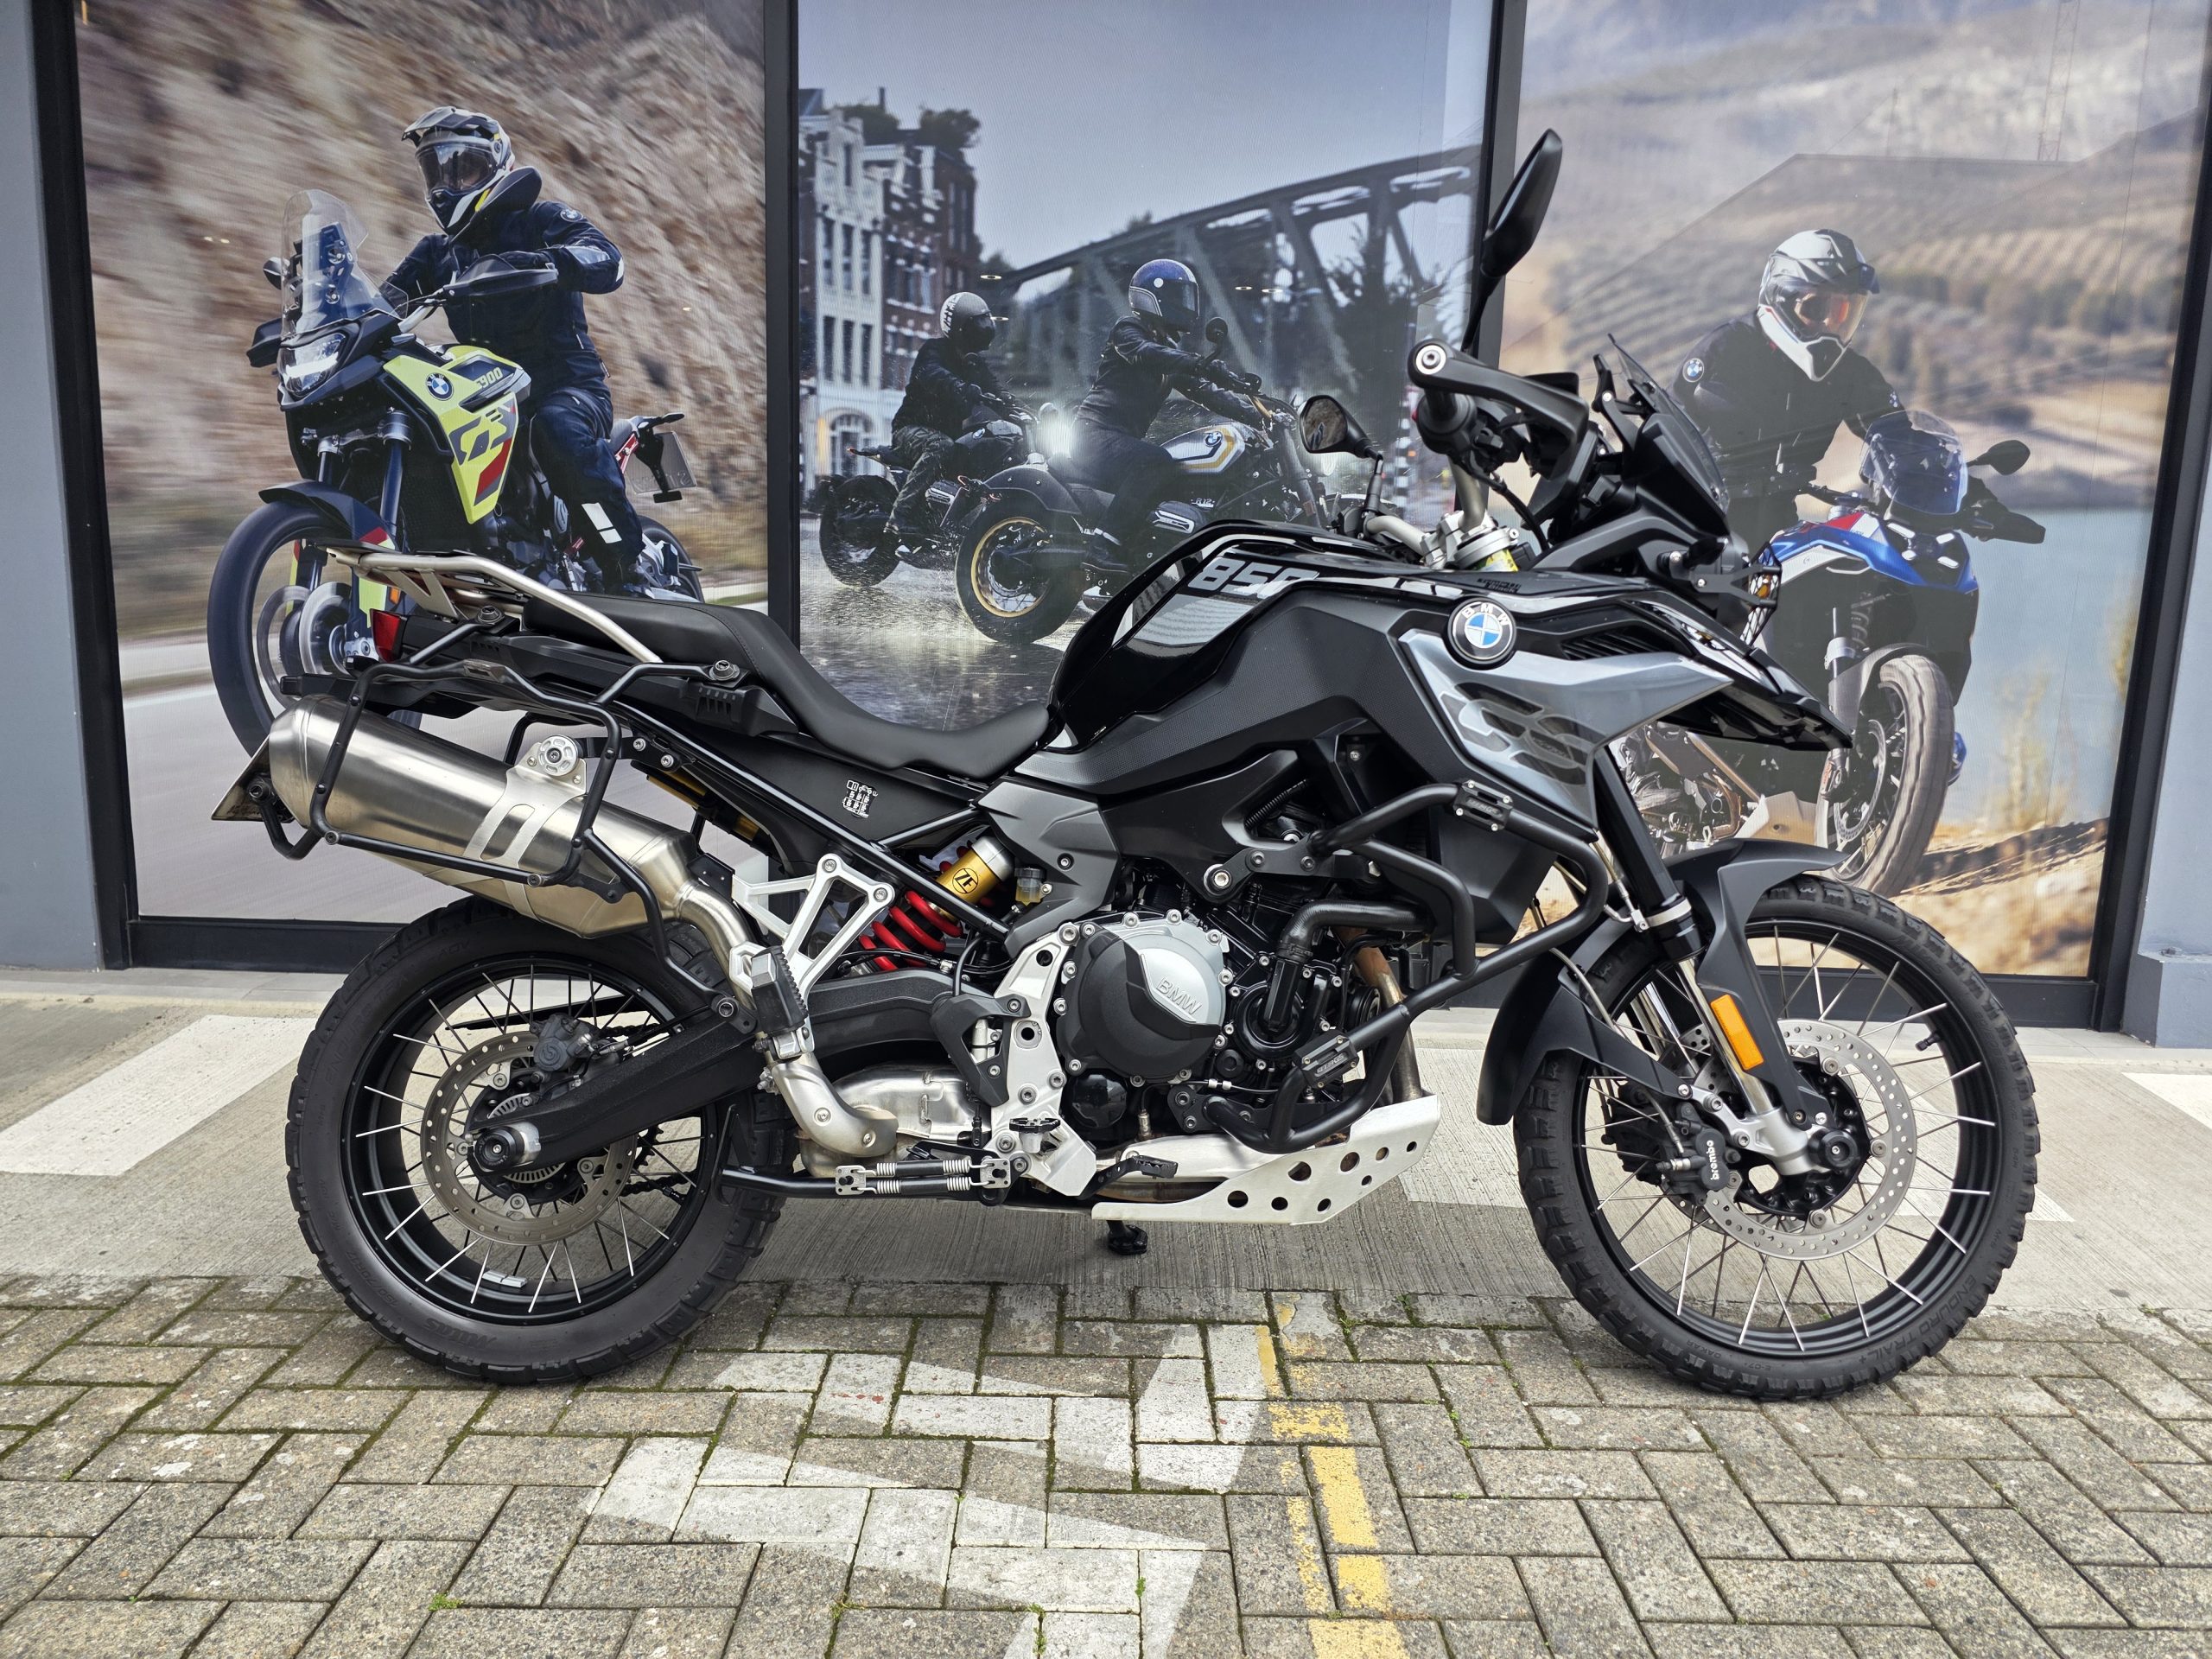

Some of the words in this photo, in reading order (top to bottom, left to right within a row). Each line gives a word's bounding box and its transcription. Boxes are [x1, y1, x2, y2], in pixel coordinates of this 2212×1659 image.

[1461, 602, 1510, 626] BMW
[952, 868, 979, 894] ZF
[1156, 976, 1202, 1015] BMW
[1706, 1140, 1719, 1180] brembo
[1919, 1274, 1978, 1337] ENDURO
[1684, 1339, 1722, 1358] DAKAR
